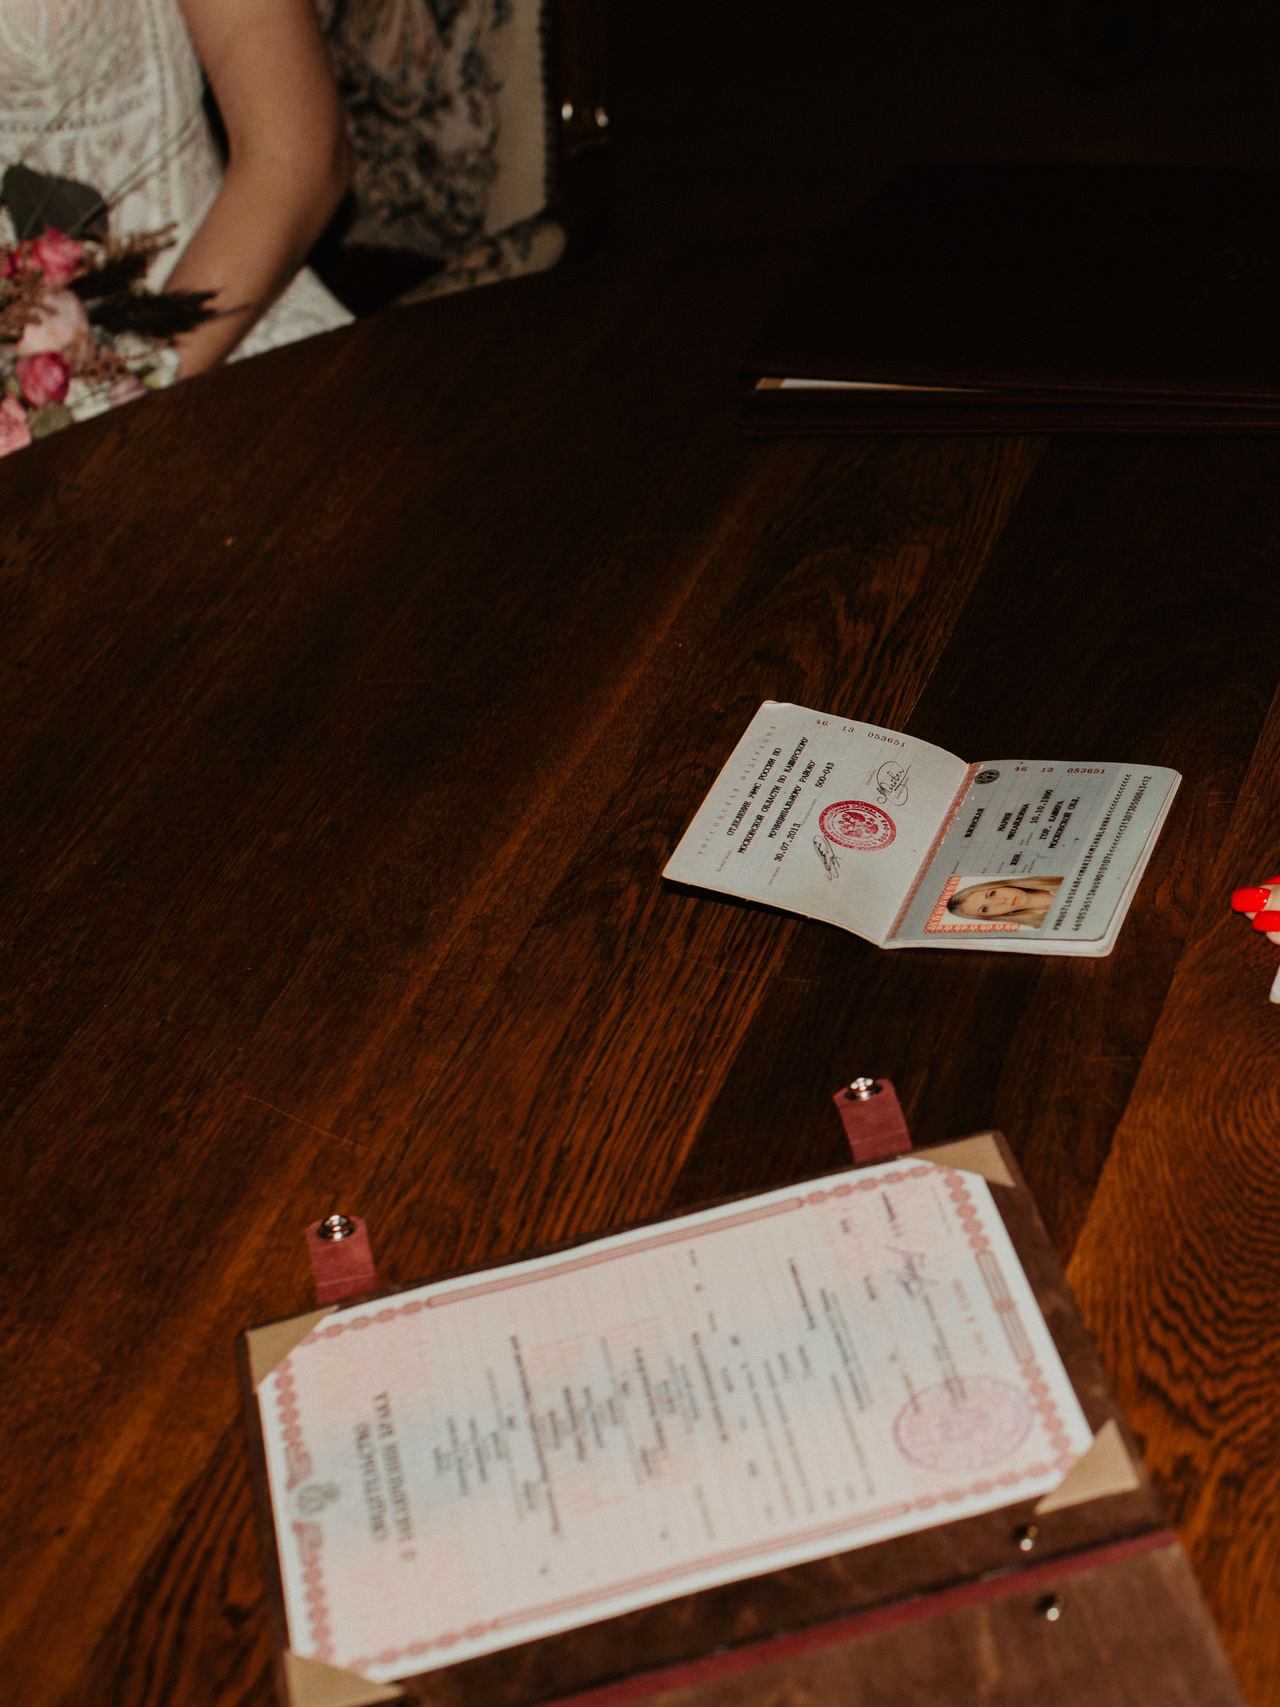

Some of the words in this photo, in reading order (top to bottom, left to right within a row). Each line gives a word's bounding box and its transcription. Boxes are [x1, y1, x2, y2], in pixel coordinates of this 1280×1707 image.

[815, 718, 829, 727] 46
[842, 725, 855, 733] 13
[867, 731, 906, 748] 053651
[726, 800, 751, 836] ОТДЕЛЕНИЕ
[747, 782, 761, 798] УФМС
[757, 757, 776, 780] РОССИИ
[771, 747, 781, 756] ПО
[814, 761, 834, 788] 500-043
[737, 814, 765, 853] МОСКОВСКОЙ
[760, 785, 781, 812] ОБЛАСТИ
[776, 774, 787, 783] ПО
[783, 736, 808, 773] КАШИРСКОМУ
[767, 784, 801, 838] МУНИЦИПАЛЬНОМУ
[798, 759, 815, 783] РАЙОНУ
[1029, 789, 1053, 823] 10.10.1990
[997, 812, 1012, 831] МАРИЯ
[1005, 803, 1030, 840] МИХАЙЛОВНА
[1038, 825, 1052, 839] ГОР.
[1047, 800, 1064, 822] КАШИРА
[1048, 812, 1072, 848] МОСКОВСКОЙ
[773, 822, 802, 862] 30.07.2013
